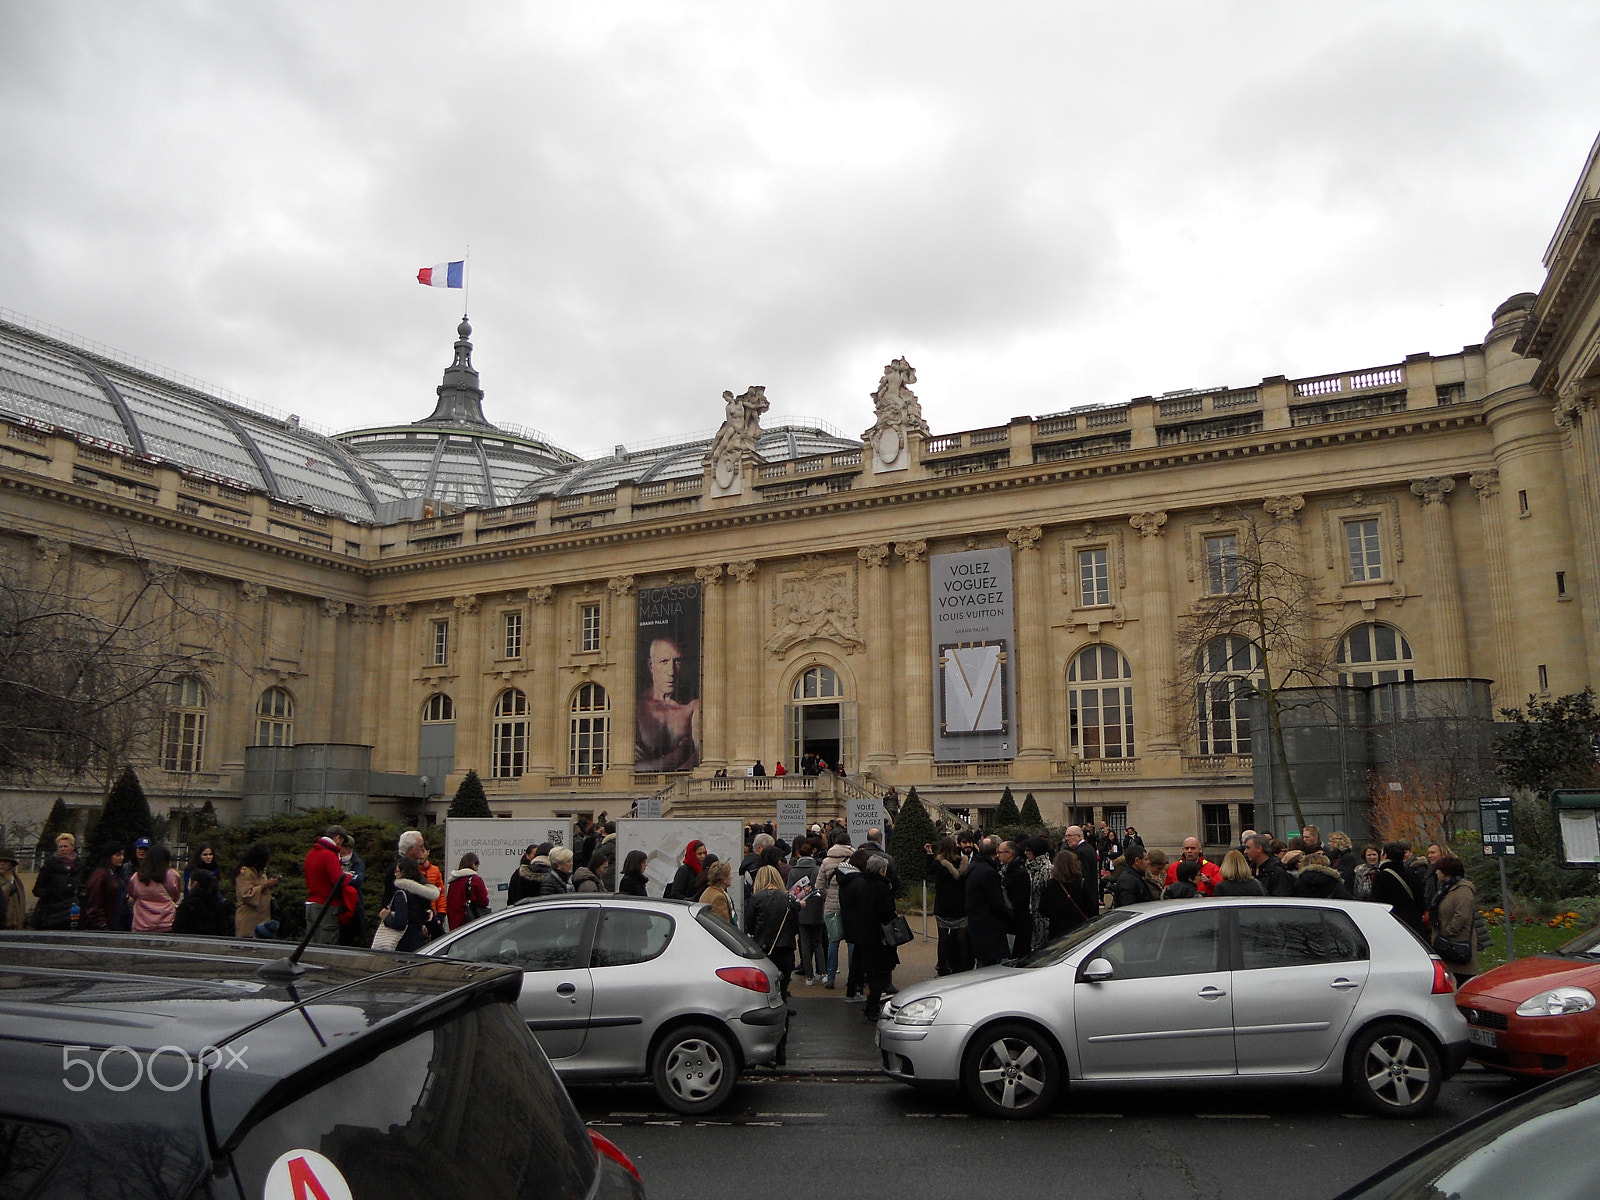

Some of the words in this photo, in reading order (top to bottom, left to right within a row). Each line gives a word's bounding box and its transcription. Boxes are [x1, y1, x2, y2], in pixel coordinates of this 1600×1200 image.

[949, 562, 990, 576] VOLEZ
[943, 577, 998, 592] VOGUEZ
[640, 585, 698, 603] PICASSO
[938, 591, 1004, 608] VOYAGEZ
[639, 602, 684, 618] MANIA
[939, 612, 964, 622] LOUIS
[966, 609, 1004, 619] VUITTON
[454, 838, 469, 847] SUR
[480, 848, 503, 856] VISITE
[505, 848, 515, 856] EN
